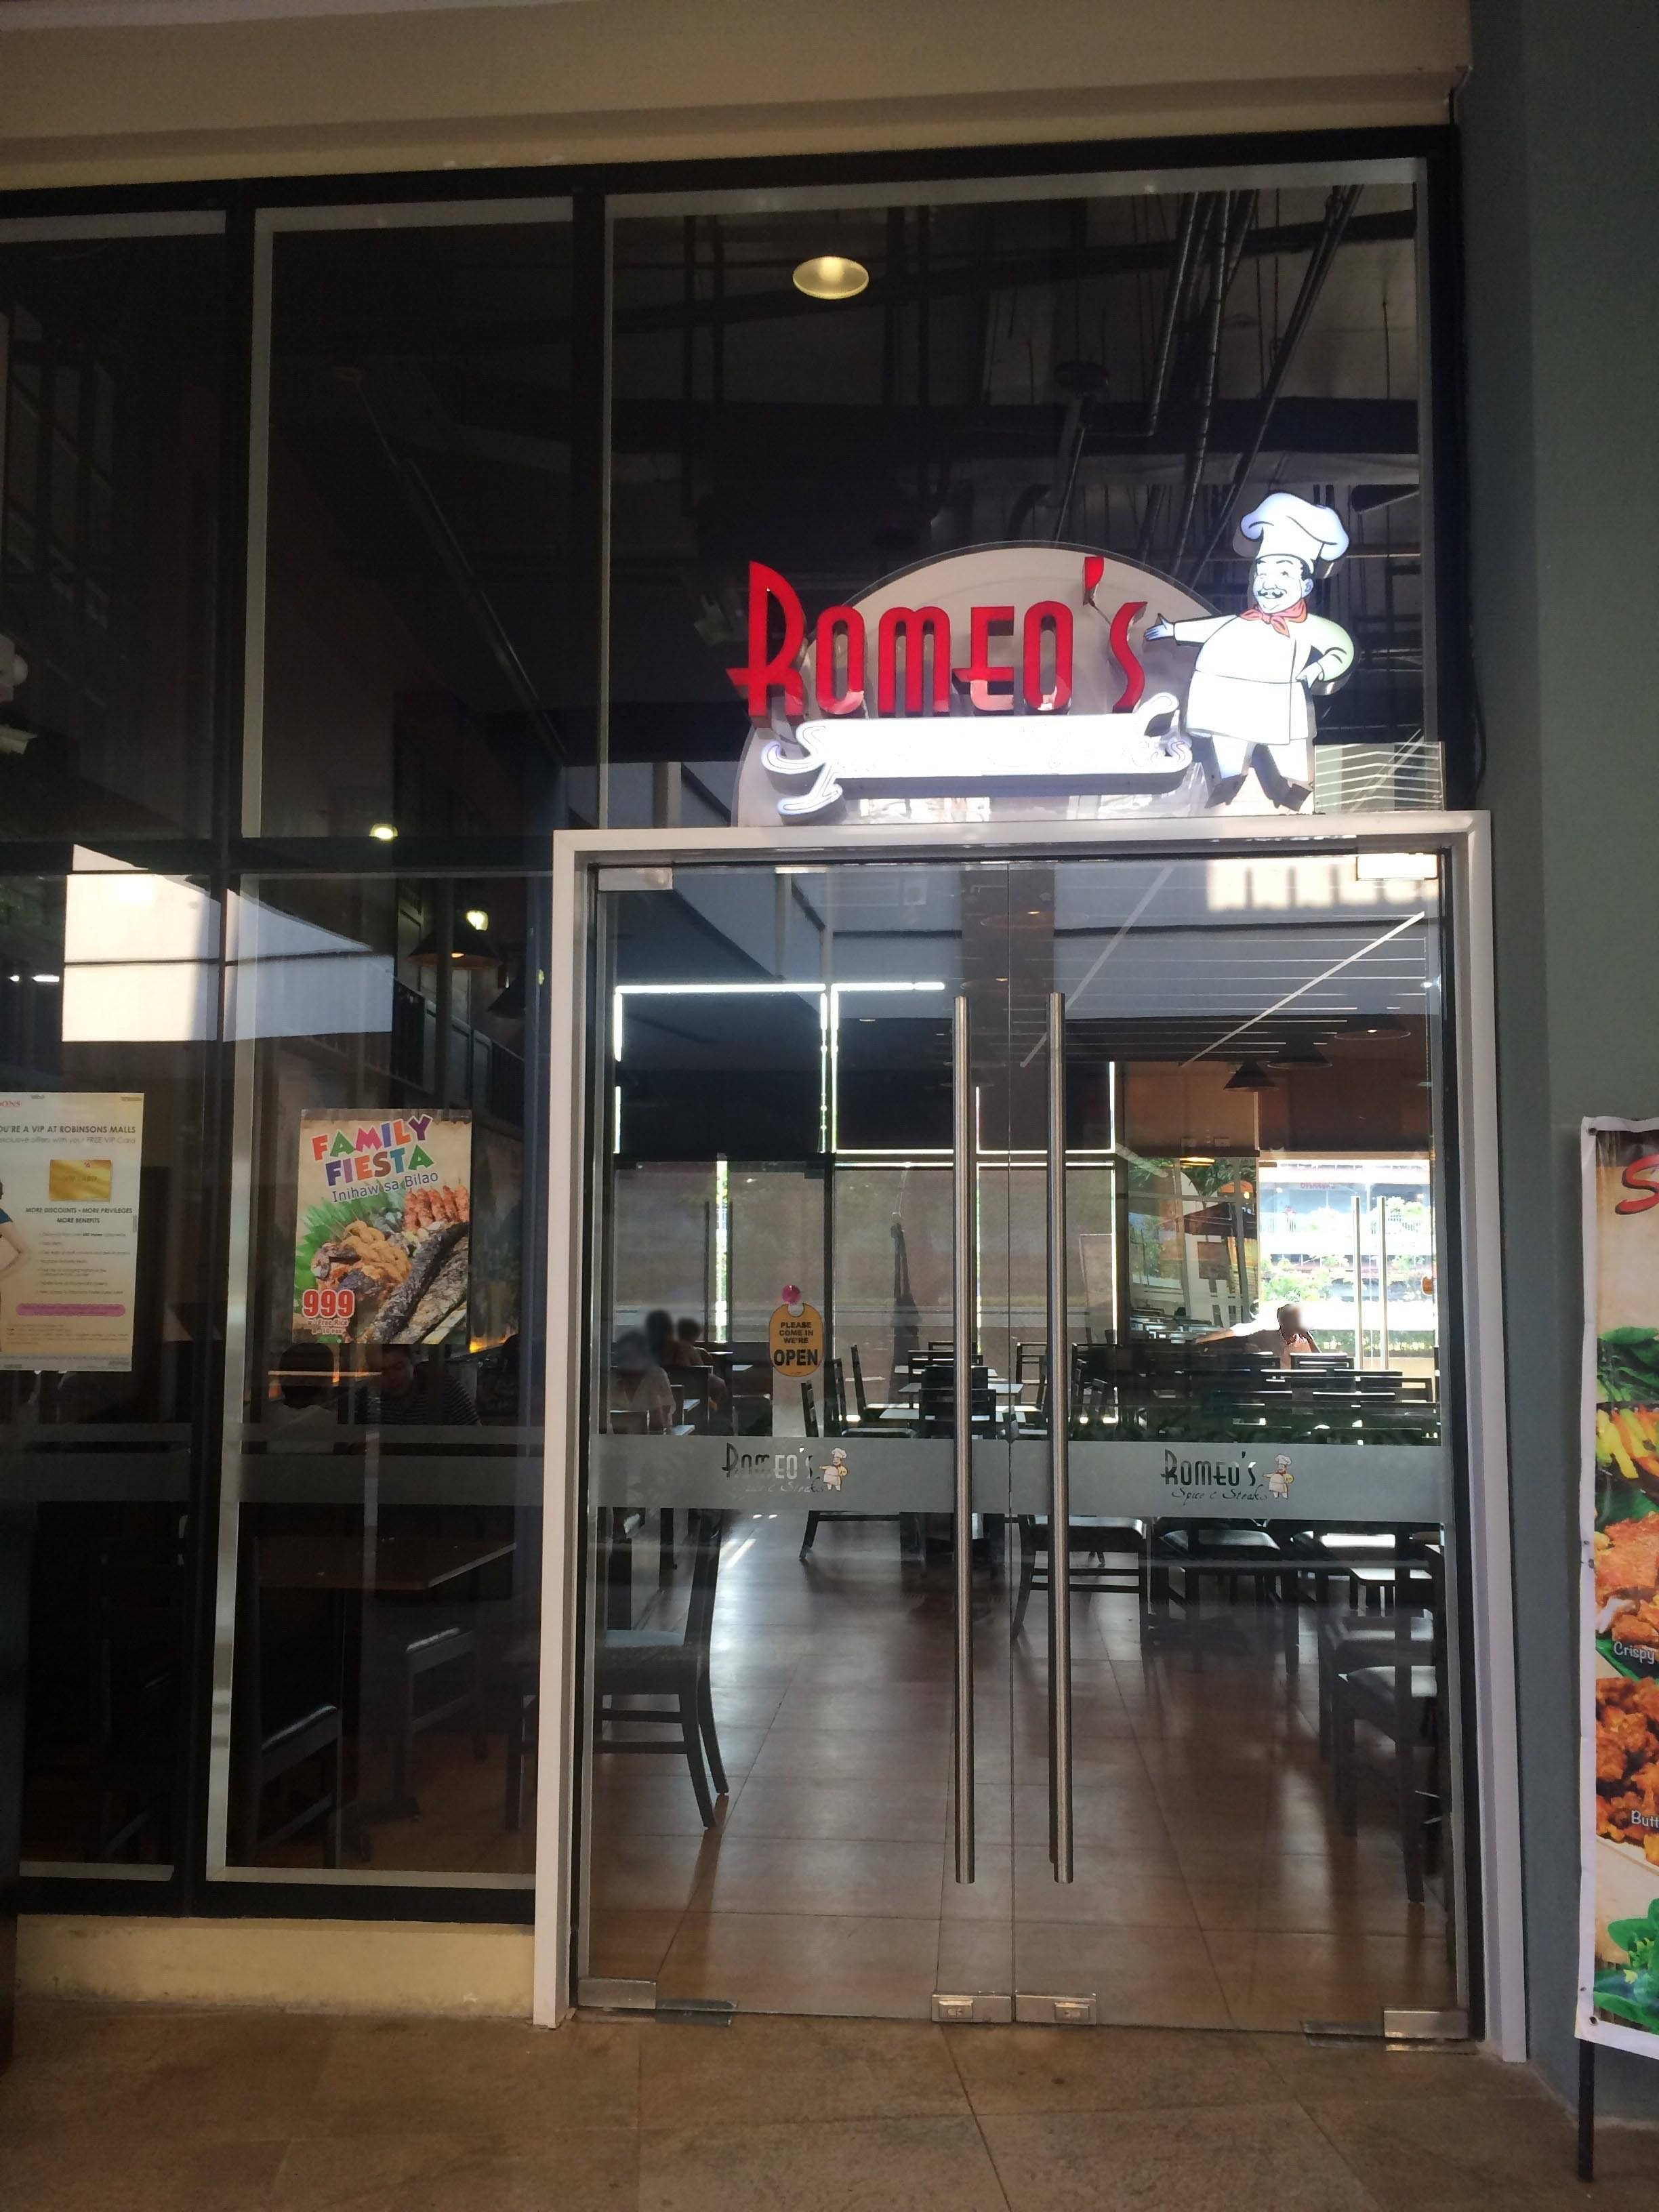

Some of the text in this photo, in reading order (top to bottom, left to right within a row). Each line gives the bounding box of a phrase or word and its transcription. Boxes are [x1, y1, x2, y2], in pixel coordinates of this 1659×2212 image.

[312, 1115, 432, 1161] FAMILY
[325, 1144, 434, 1186] FIESTA
[332, 1172, 438, 1202] Inihaw sa Bilao
[302, 1290, 354, 1317] 999
[773, 1349, 818, 1366] OPEN
[1614, 1641, 1654, 1664] Crispy
[1631, 1809, 1659, 1828] Butt
